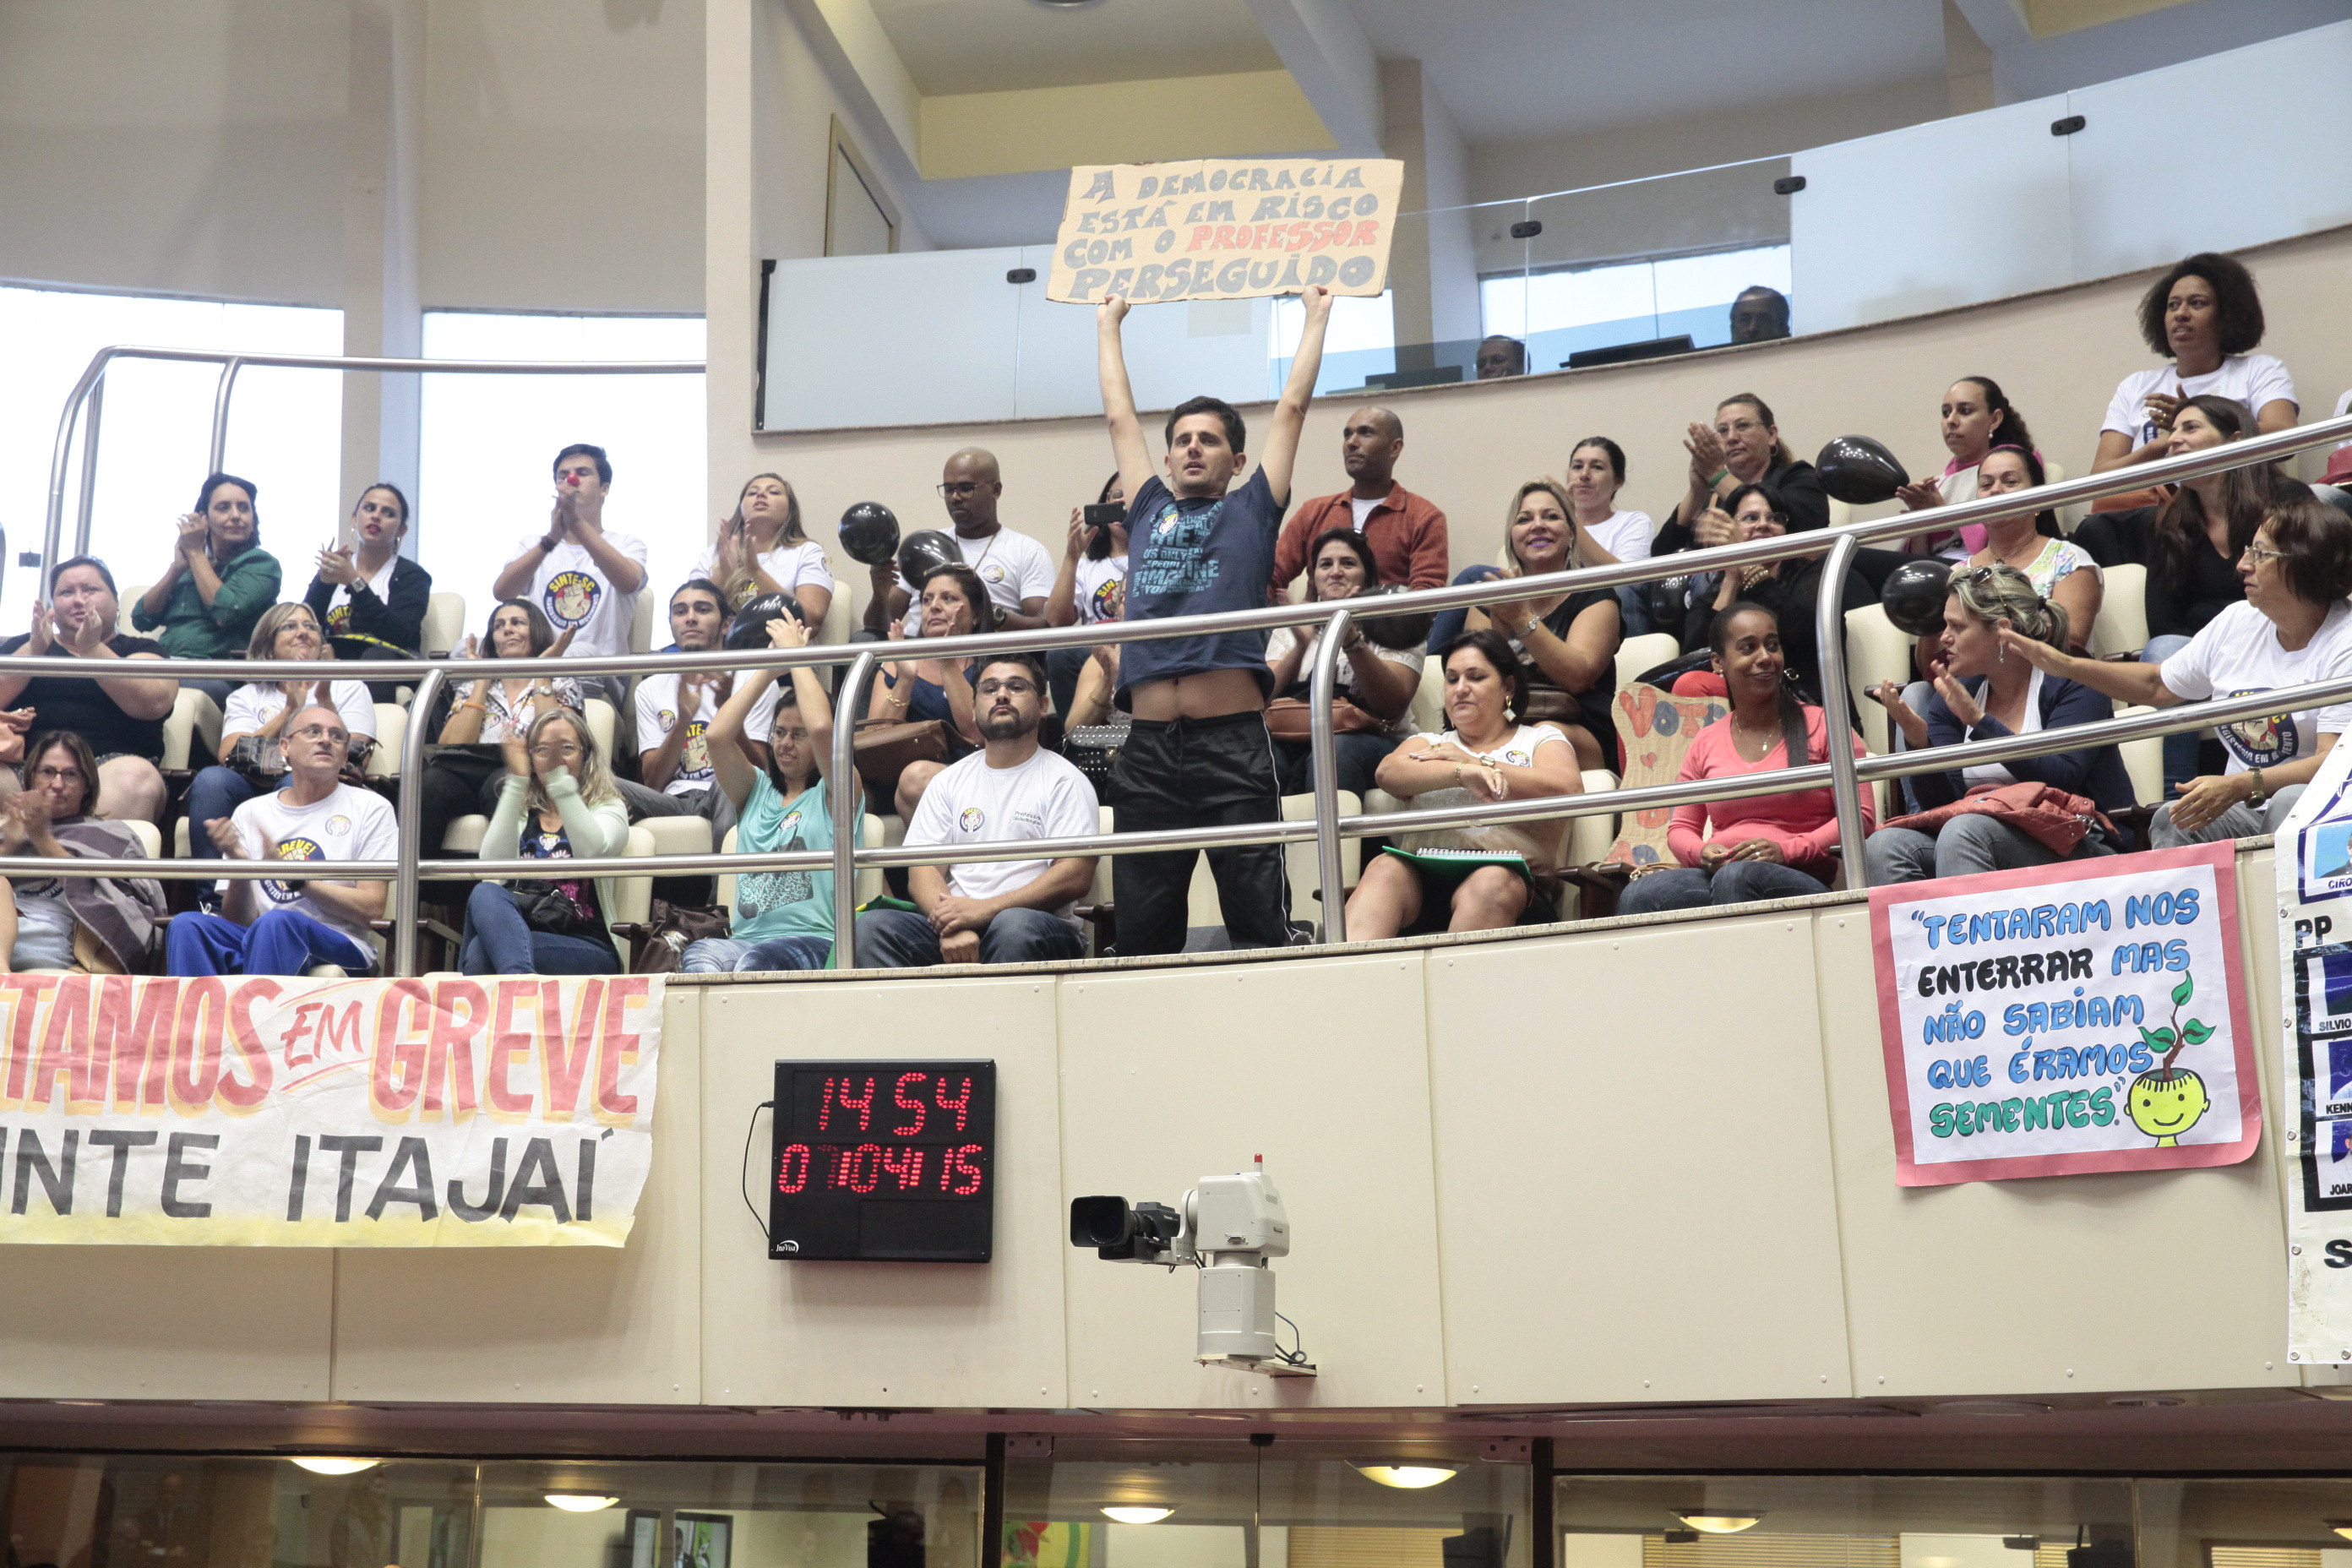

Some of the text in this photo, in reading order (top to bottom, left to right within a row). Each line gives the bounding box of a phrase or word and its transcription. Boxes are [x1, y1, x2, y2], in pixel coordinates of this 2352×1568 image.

[1080, 166, 1366, 205] A DEMOCRACIA
[1075, 191, 1379, 235] ESTÁ EM RISCO
[1063, 219, 1380, 270] COM O PROFESSOR
[548, 573, 596, 593] SINTE-SC
[2255, 754, 2269, 764] EM
[2125, 888, 2200, 930] NOS
[2295, 915, 2333, 949] PP
[1917, 939, 2191, 998] ENTERRAR MAS
[1923, 986, 2144, 1046] NÃO SABIAM
[2318, 1018, 2352, 1032] SILVIO
[279, 999, 365, 1070] EM
[372, 976, 650, 1117] GREVE
[1927, 1036, 2153, 1090] QUE ÉRAMOS
[286, 1127, 615, 1224] ITAJAÍ
